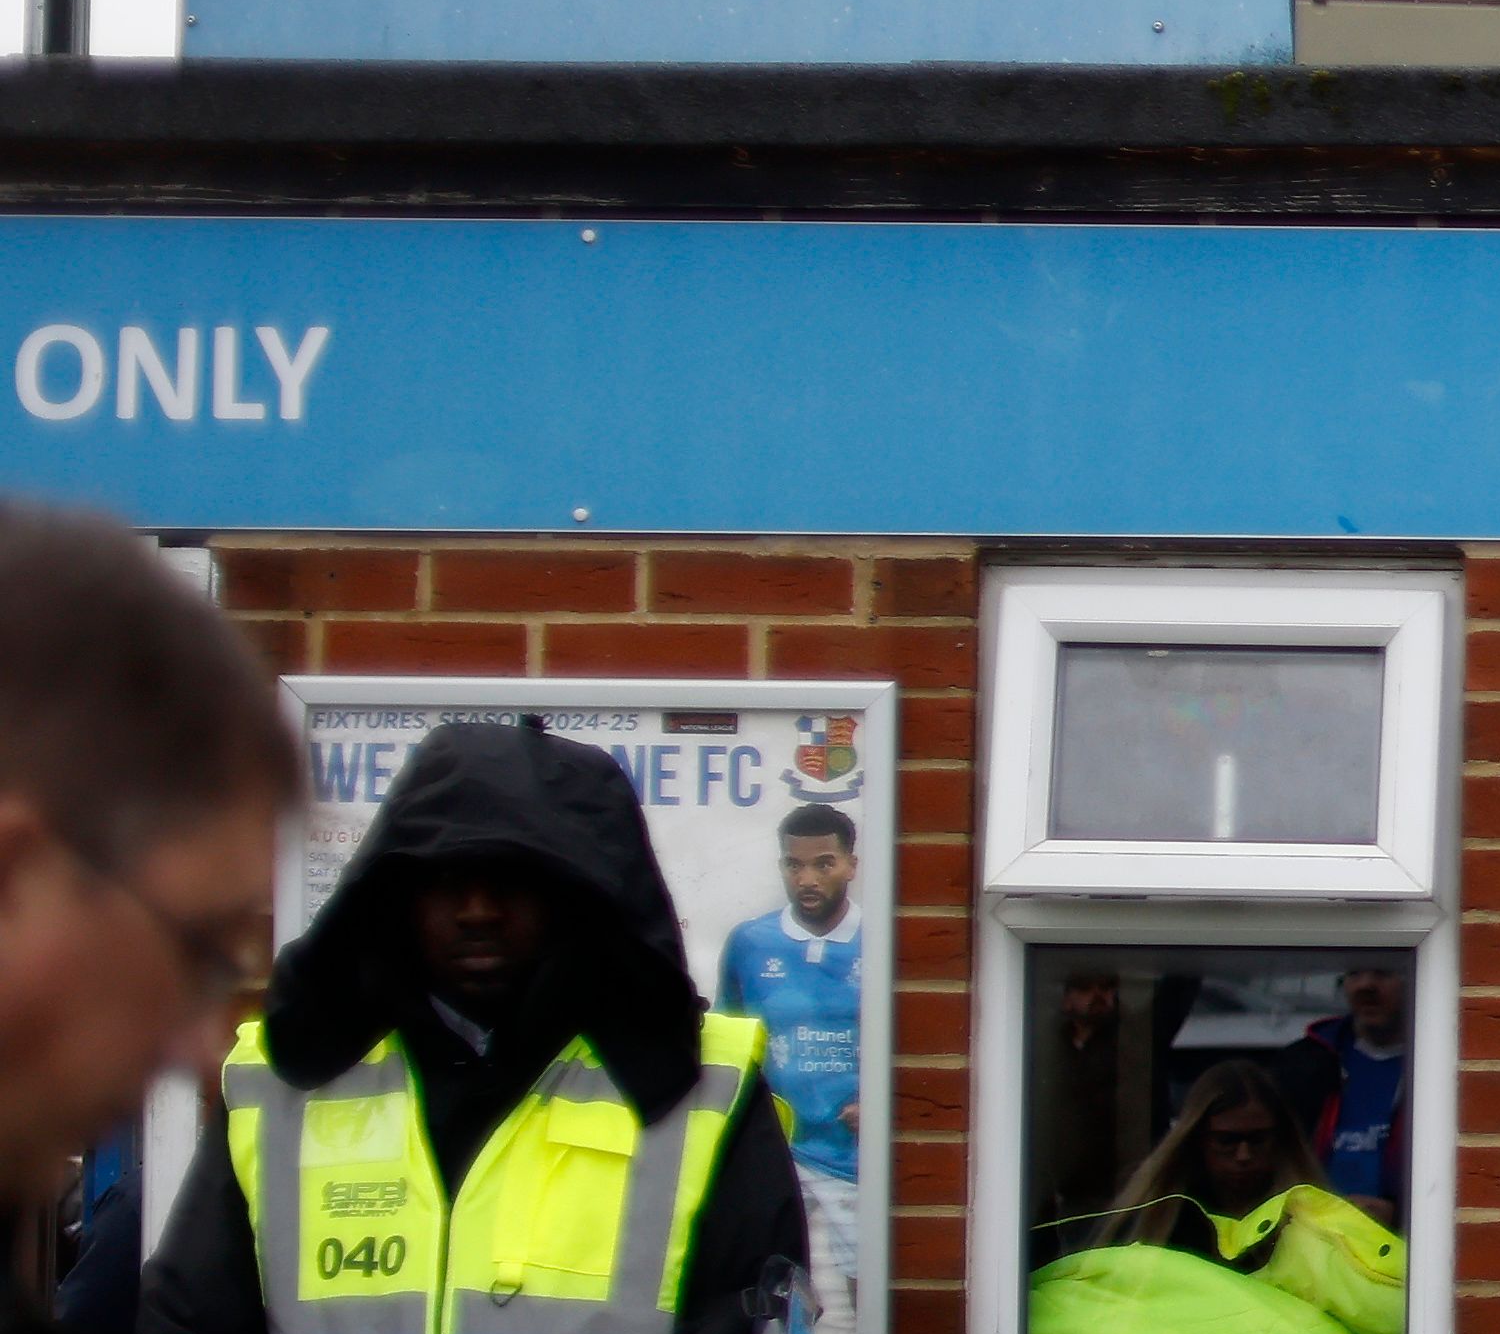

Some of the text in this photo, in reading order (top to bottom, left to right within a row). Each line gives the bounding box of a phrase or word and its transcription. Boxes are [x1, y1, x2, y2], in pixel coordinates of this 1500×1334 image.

[14, 322, 329, 421] ONLY
[311, 711, 639, 732] FIXTURES, 2024-25
[699, 745, 761, 807] FC
[797, 1026, 852, 1044] Brunel
[797, 1060, 852, 1072] London
[317, 1235, 406, 1280] 040
